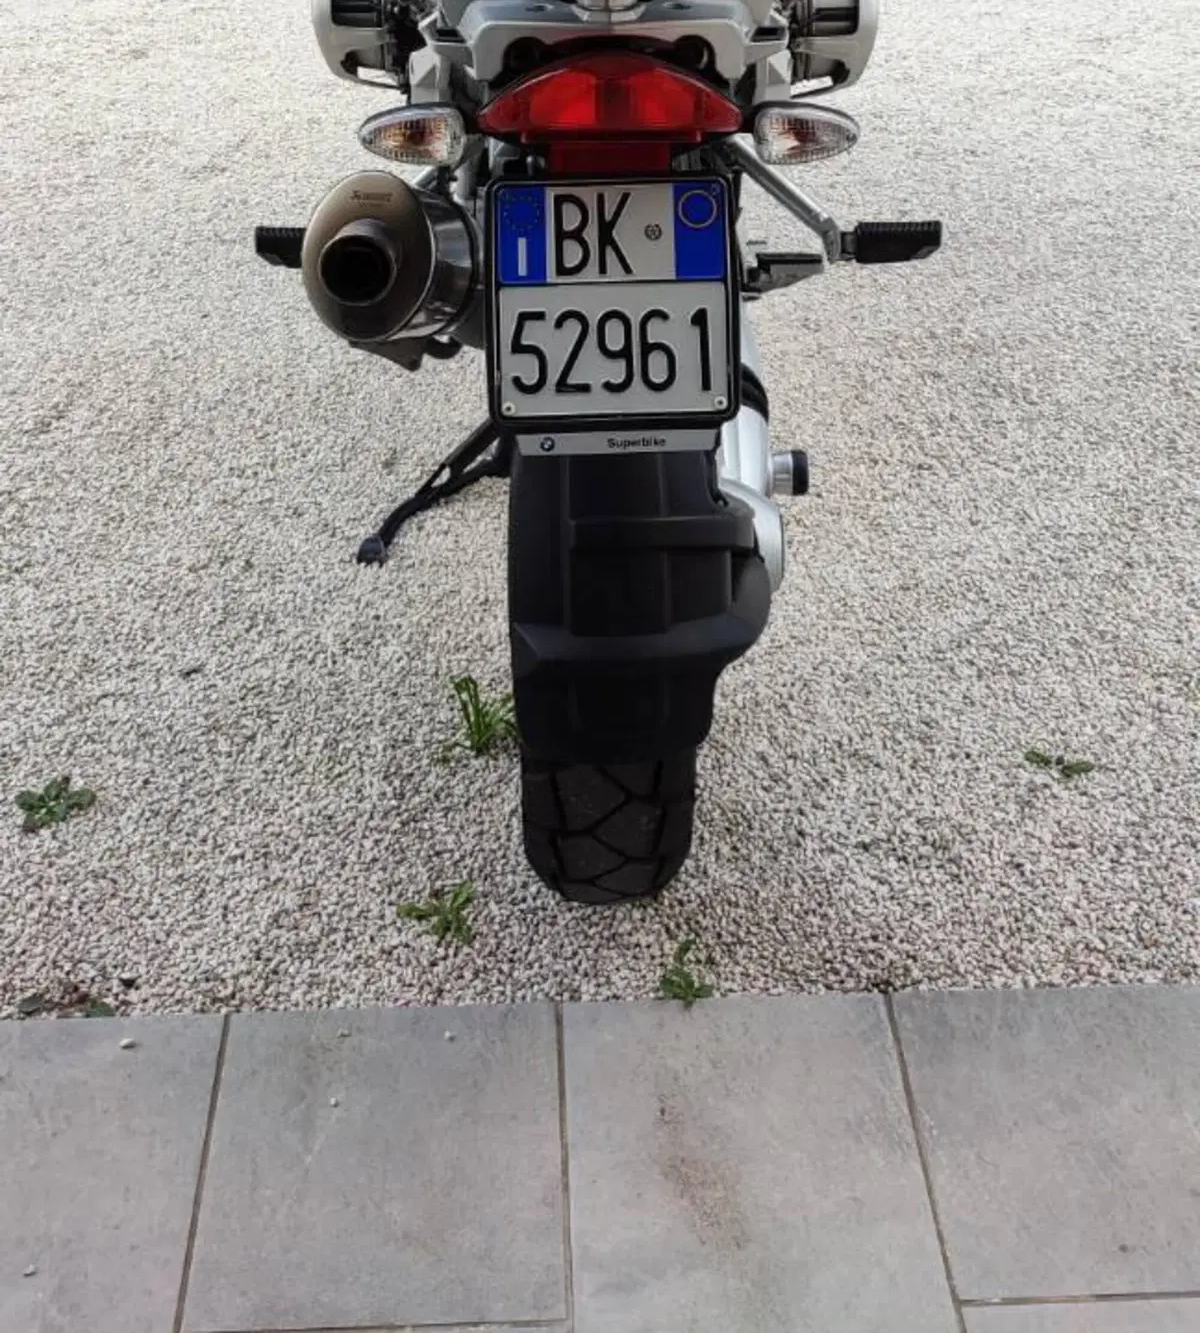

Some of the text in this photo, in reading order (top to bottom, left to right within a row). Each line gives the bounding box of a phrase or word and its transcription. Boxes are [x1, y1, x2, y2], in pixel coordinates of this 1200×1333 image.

[518, 192, 633, 276] I BK
[511, 307, 711, 395] 52961
[607, 436, 666, 450] Superbike
